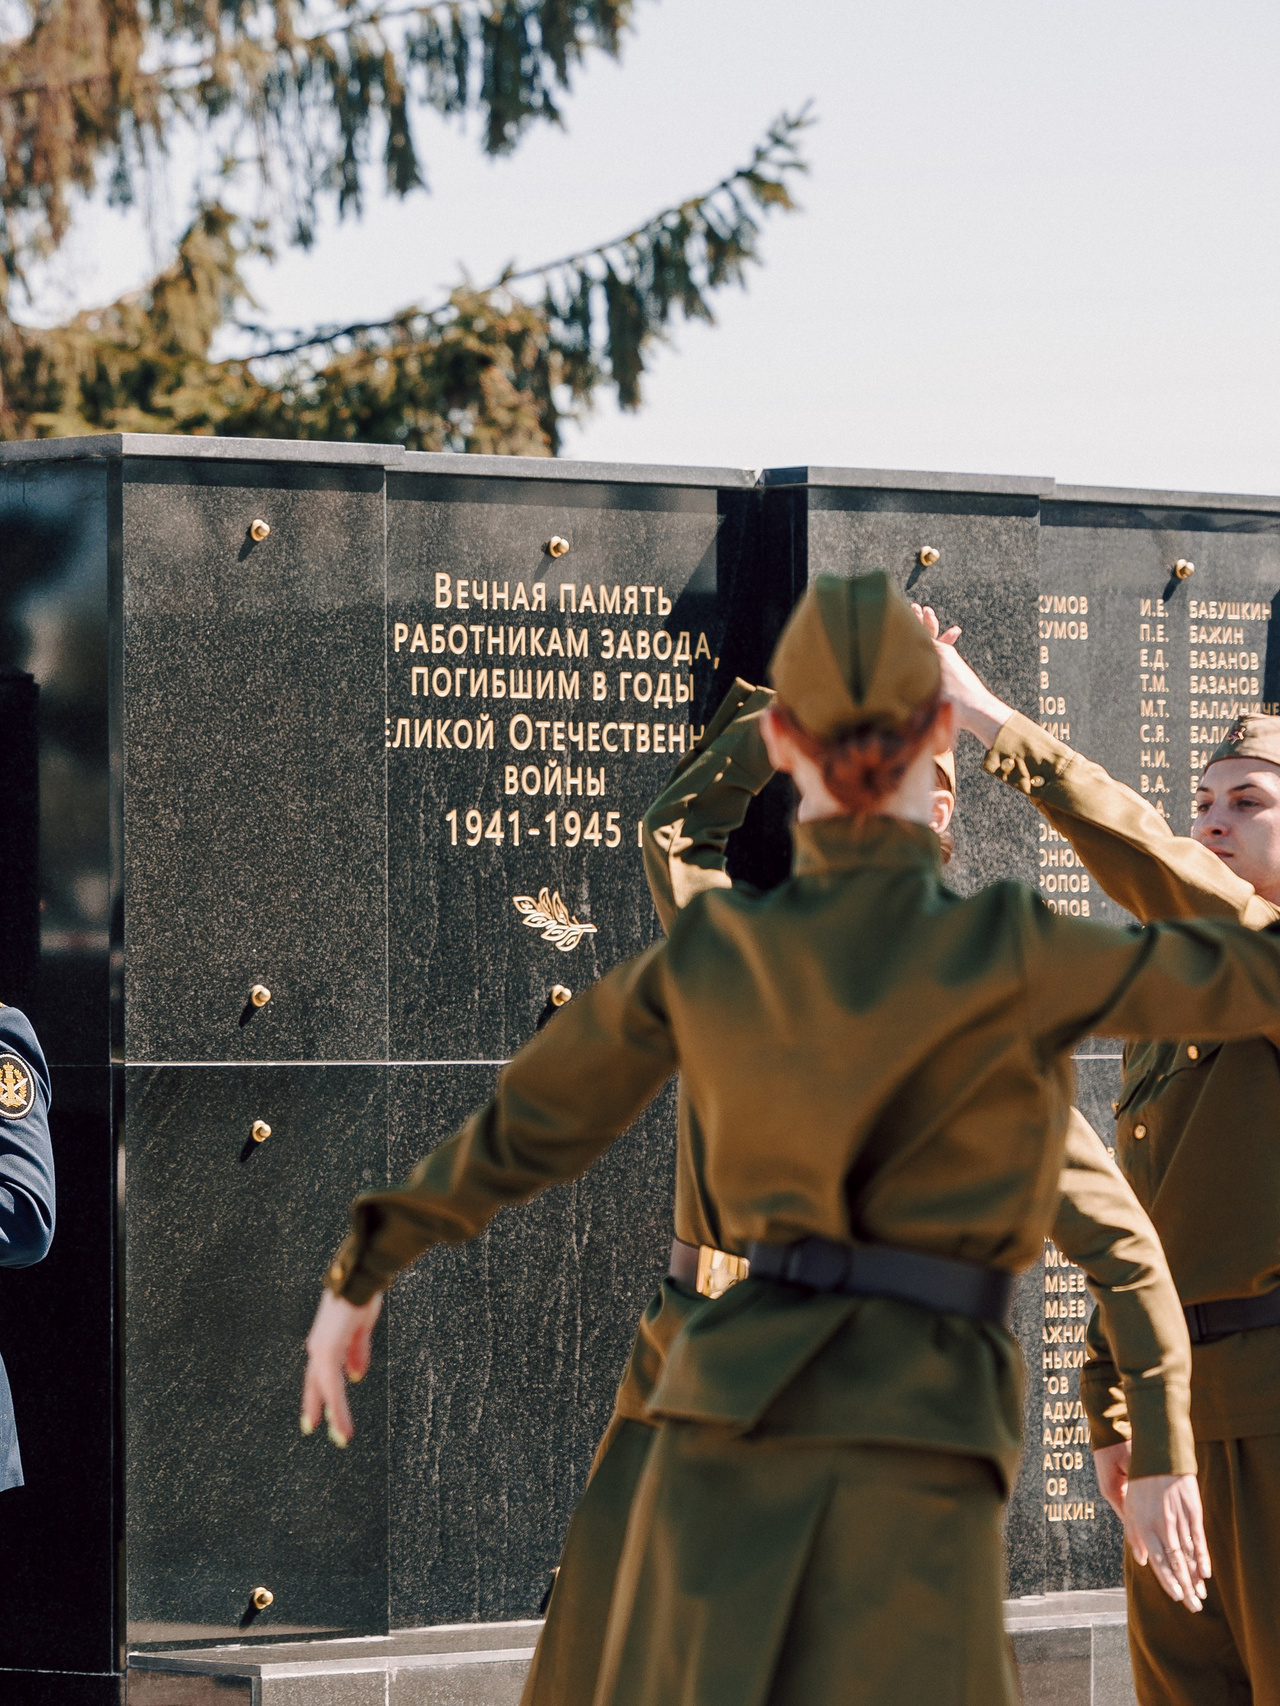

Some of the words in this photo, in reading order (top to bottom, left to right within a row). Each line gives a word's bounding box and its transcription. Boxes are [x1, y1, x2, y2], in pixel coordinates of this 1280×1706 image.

[558, 583, 673, 616] ПАМЯТЬ
[1189, 600, 1272, 621] БАБУШКИН
[1140, 624, 1170, 643] П.Е.
[1189, 625, 1245, 645] БАЖИН
[394, 622, 589, 657] РАБОТНИКАМ
[600, 628, 721, 669] ЗАВОДА,
[1140, 648, 1170, 672] Е.Д.
[1189, 650, 1260, 671] БАЗАНОВ
[411, 666, 580, 700] ПОГИБШИМ
[592, 671, 608, 702] В
[620, 671, 695, 709] ГОДЫ
[1139, 673, 1170, 693] Т.М.
[1189, 675, 1260, 696] БАЗАНОВ
[1140, 699, 1170, 718] М.Т.
[1140, 724, 1170, 743] С.Я.
[1140, 749, 1170, 768] Н.И.
[504, 759, 605, 796] ВОЙНЫ
[1140, 774, 1170, 793] В.А.
[445, 809, 621, 847] 1941-1945
